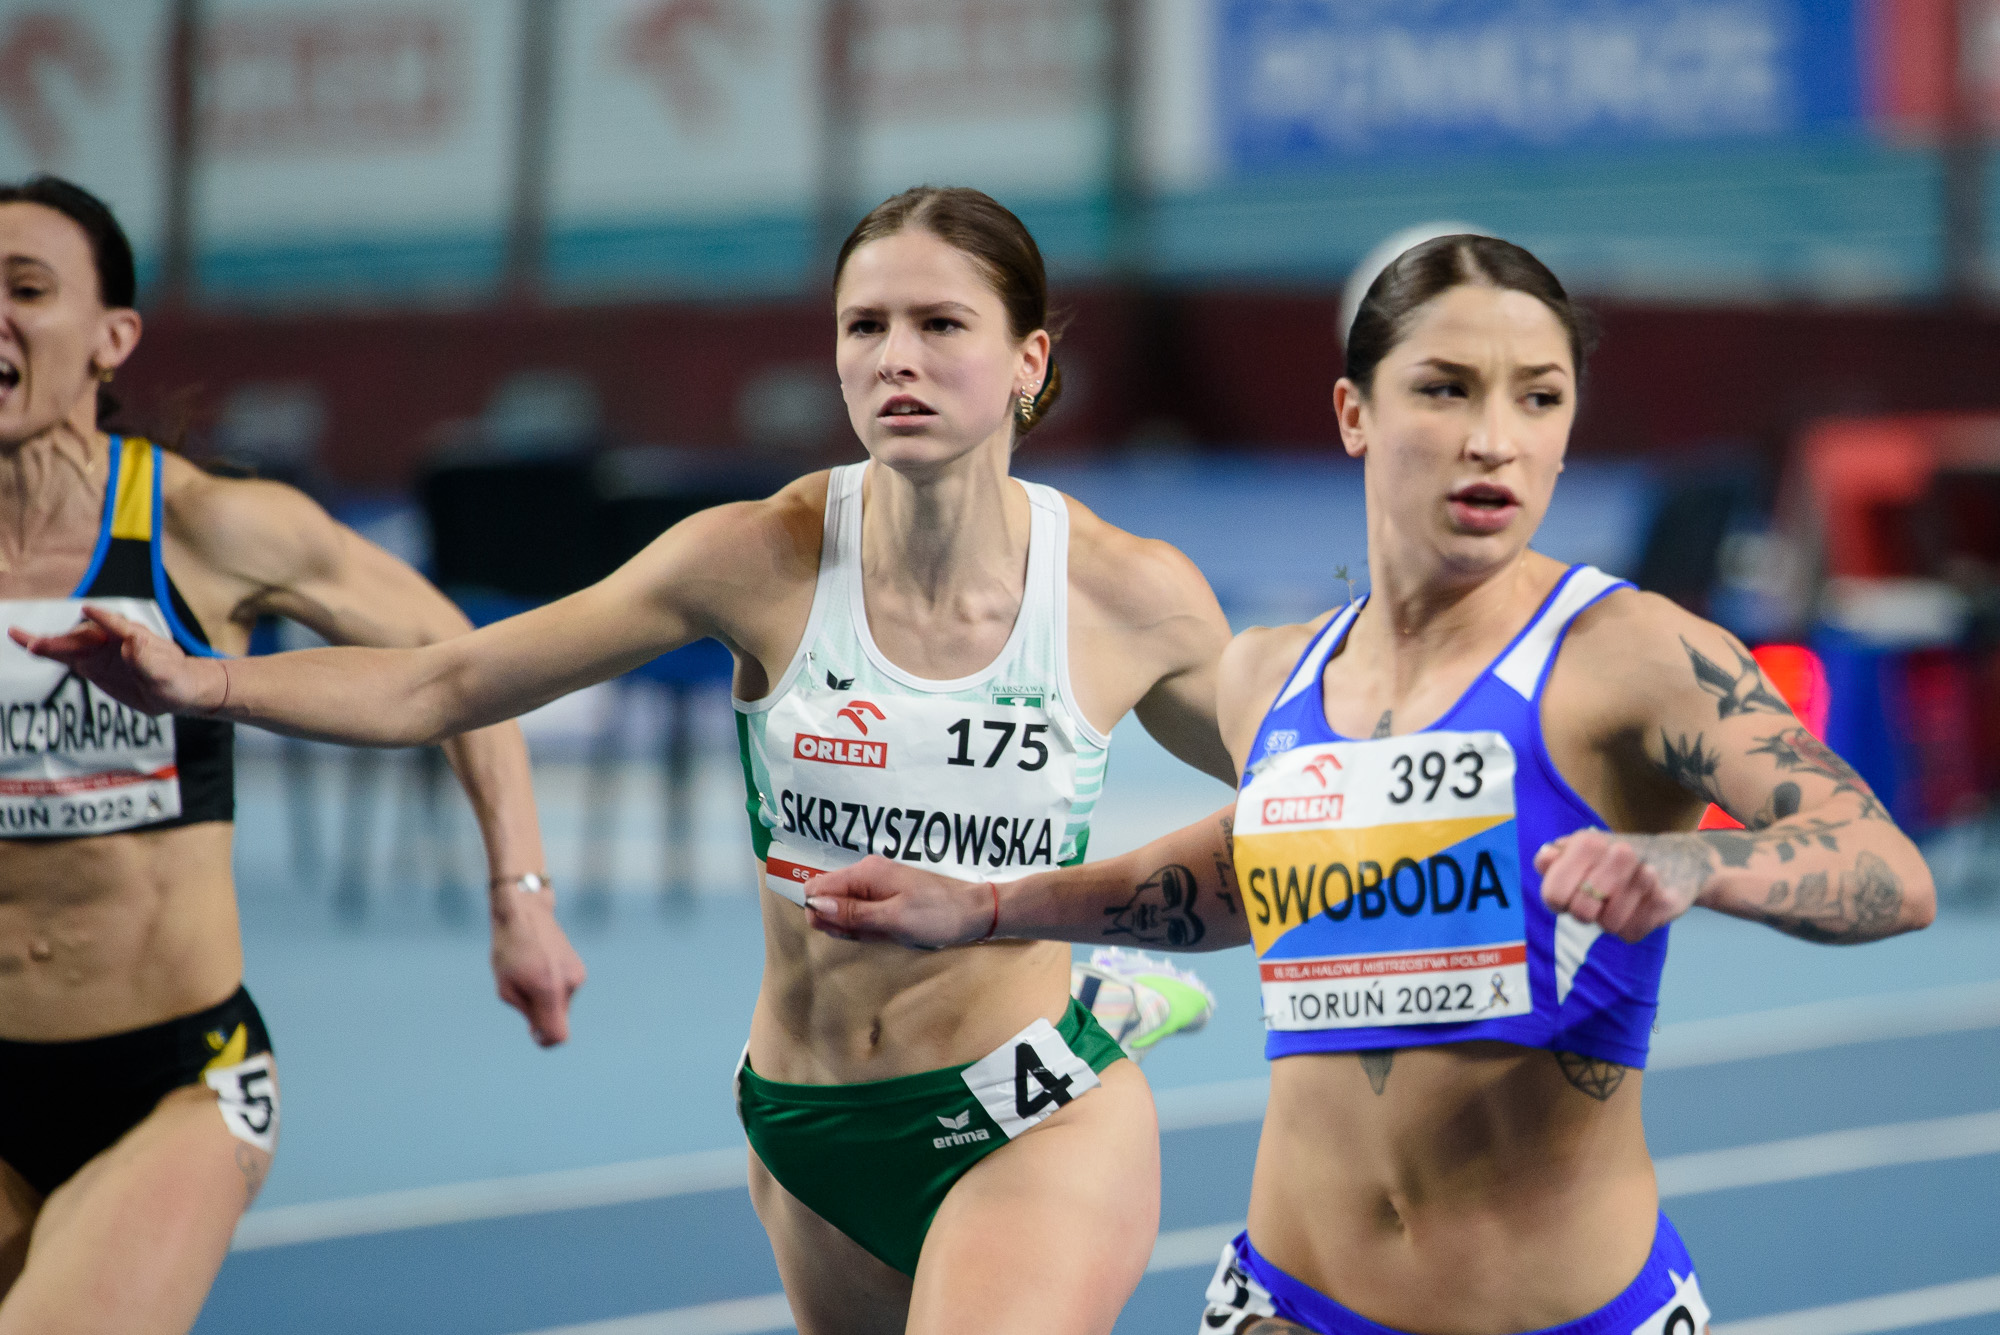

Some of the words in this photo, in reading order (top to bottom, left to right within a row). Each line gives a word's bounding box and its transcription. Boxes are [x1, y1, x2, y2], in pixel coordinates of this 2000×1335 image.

[993, 685, 1044, 693] WARSZAWA
[798, 738, 882, 765] ORLEN
[946, 718, 1049, 772] 175
[1387, 750, 1484, 804] 393
[61, 796, 132, 826] 2022
[780, 789, 1051, 868] SKRZYSZOWSKA
[1264, 797, 1341, 822] ORLEN
[1249, 851, 1510, 926] SWOBODA
[1311, 962, 1360, 977] HALOWE
[1362, 956, 1447, 974] MISTRZOSTWA
[1449, 952, 1501, 967] POLSKI
[1289, 980, 1384, 1021] TORUŃ
[1397, 983, 1474, 1014] 2022
[1014, 1042, 1074, 1119] 4
[239, 1069, 273, 1134] 5
[933, 1128, 990, 1149] erima
